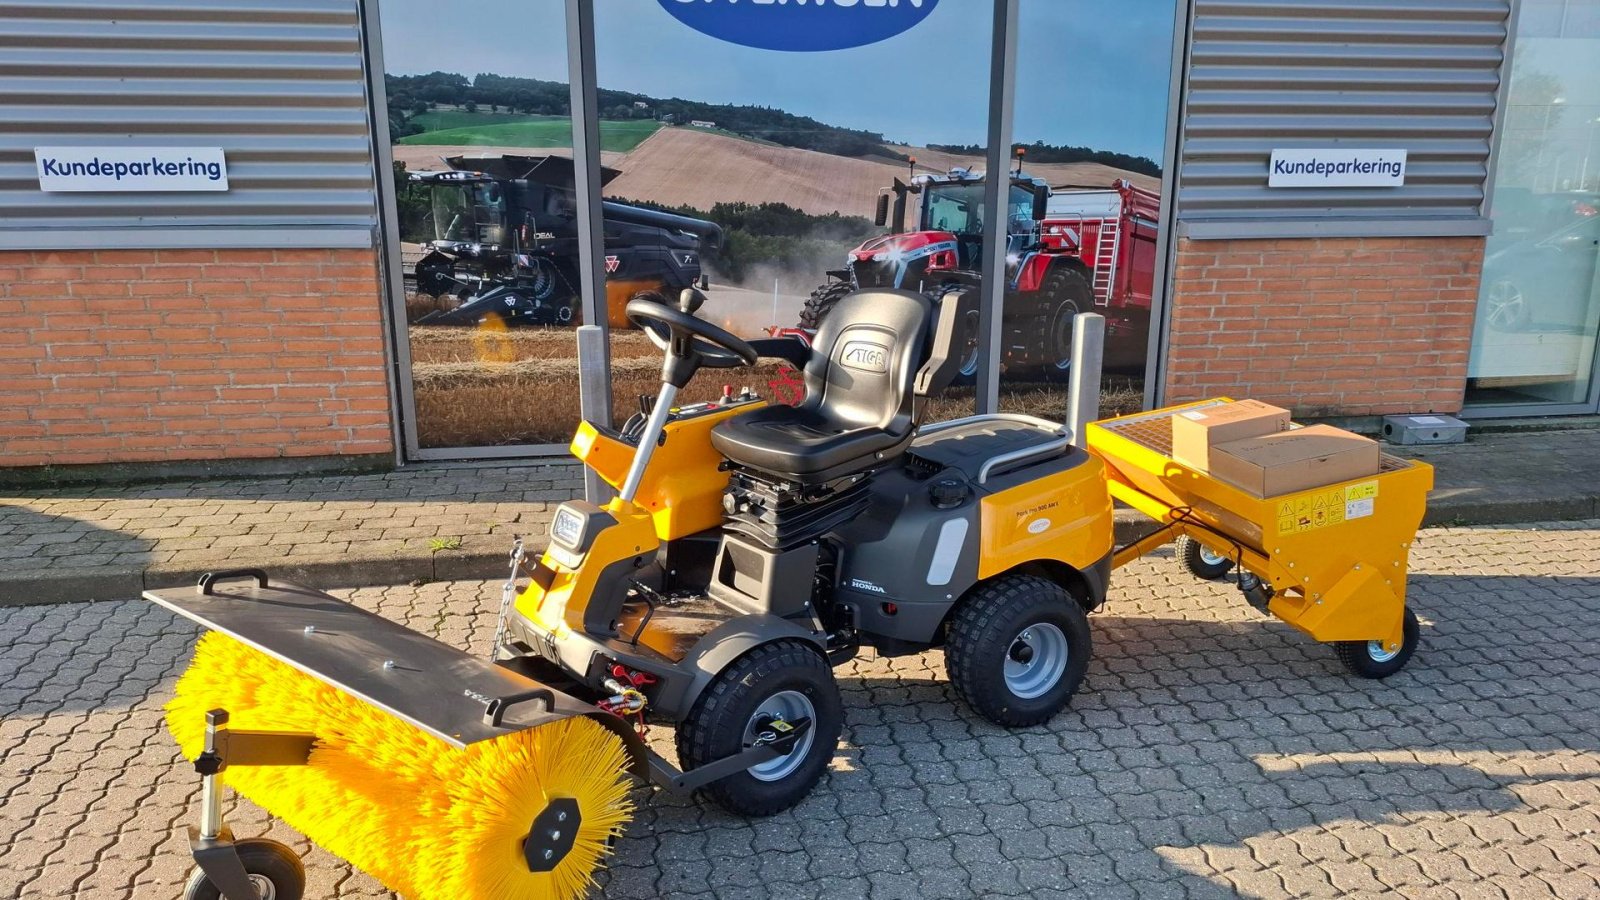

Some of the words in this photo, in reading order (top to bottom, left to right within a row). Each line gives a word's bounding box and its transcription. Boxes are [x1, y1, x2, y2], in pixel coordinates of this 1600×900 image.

[42, 157, 221, 181] Kundeparkering
[1274, 158, 1402, 178] Kundeparkering
[534, 232, 555, 240] IDEAL
[852, 581, 886, 593] HONDA
